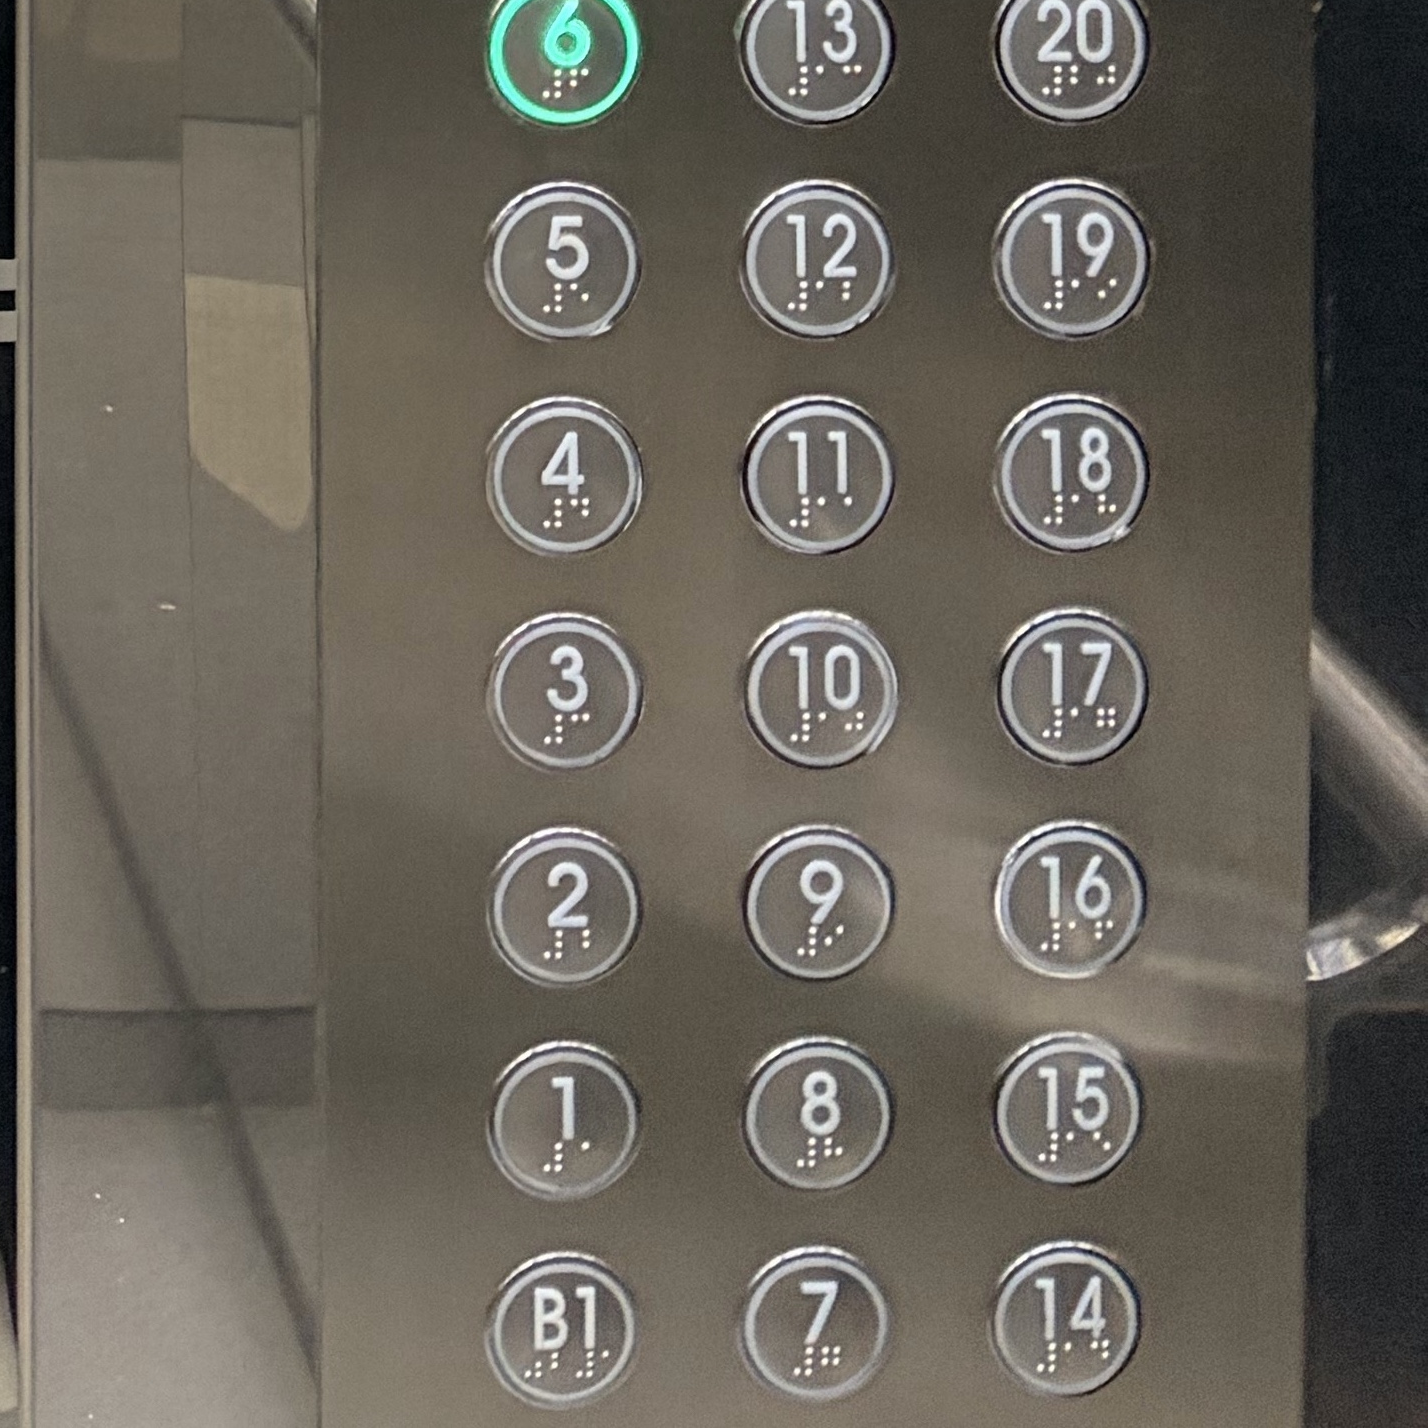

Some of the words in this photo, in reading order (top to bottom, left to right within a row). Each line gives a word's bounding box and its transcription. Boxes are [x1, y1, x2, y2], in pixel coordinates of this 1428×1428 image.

[786, 0, 859, 63] 13
[545, 216, 589, 279] 5
[786, 214, 859, 278] 12
[1040, 212, 1114, 276] 19
[540, 432, 585, 495] 4
[787, 430, 850, 493] 11
[1040, 428, 1112, 492] 18
[546, 645, 589, 712] 3
[789, 644, 862, 709] 10
[1042, 643, 1114, 706] 17
[547, 863, 588, 927] 2
[800, 860, 844, 923] 9
[1040, 856, 1112, 920] 16
[552, 1078, 576, 1140] 1
[800, 1072, 842, 1135] 8
[1039, 1067, 1110, 1131] 15
[532, 1287, 598, 1350] B1
[799, 1283, 839, 1343] 7
[1036, 1277, 1105, 1340] 14
